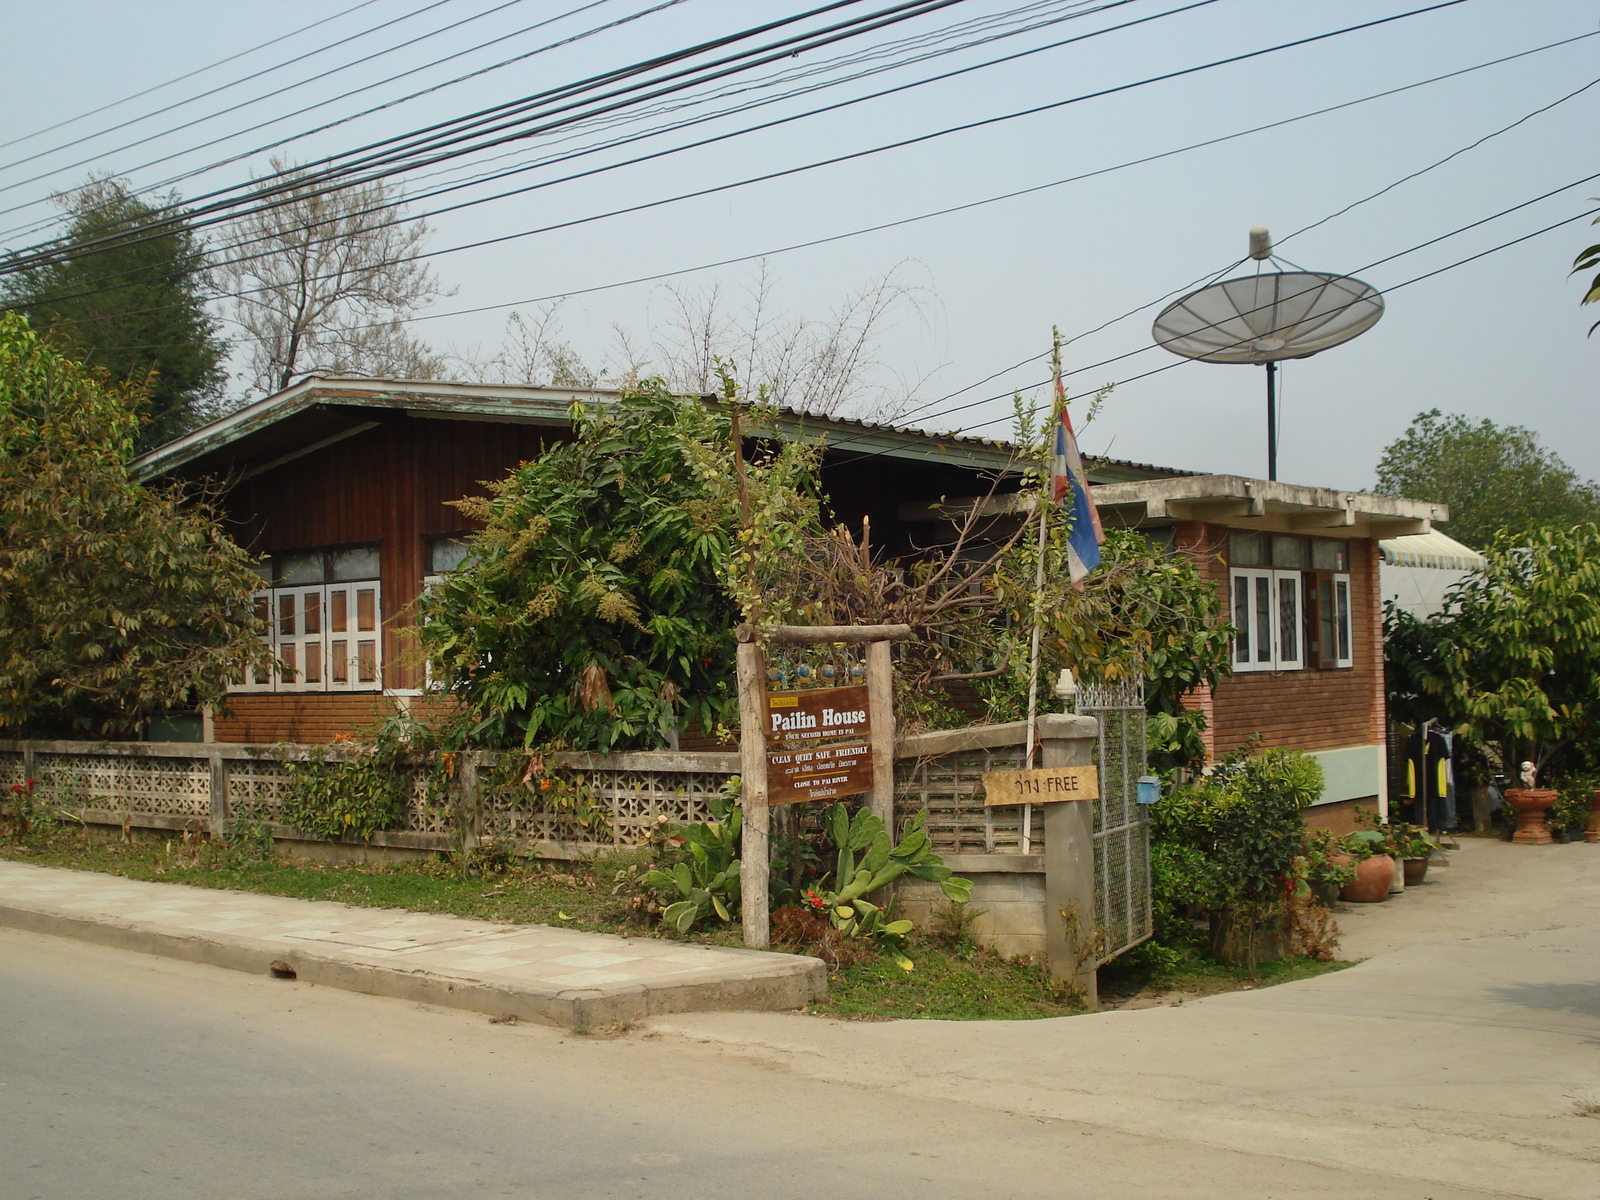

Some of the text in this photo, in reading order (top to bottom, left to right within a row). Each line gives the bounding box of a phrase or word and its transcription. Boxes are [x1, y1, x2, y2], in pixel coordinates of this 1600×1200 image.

[771, 709, 866, 731] Pailin House
[801, 731, 821, 739] SECOND
[772, 746, 868, 764] CLEAN QUIET SAFE FRIENDLY
[794, 780, 811, 788] CLOSE
[1015, 774, 1040, 794] ว่าง
